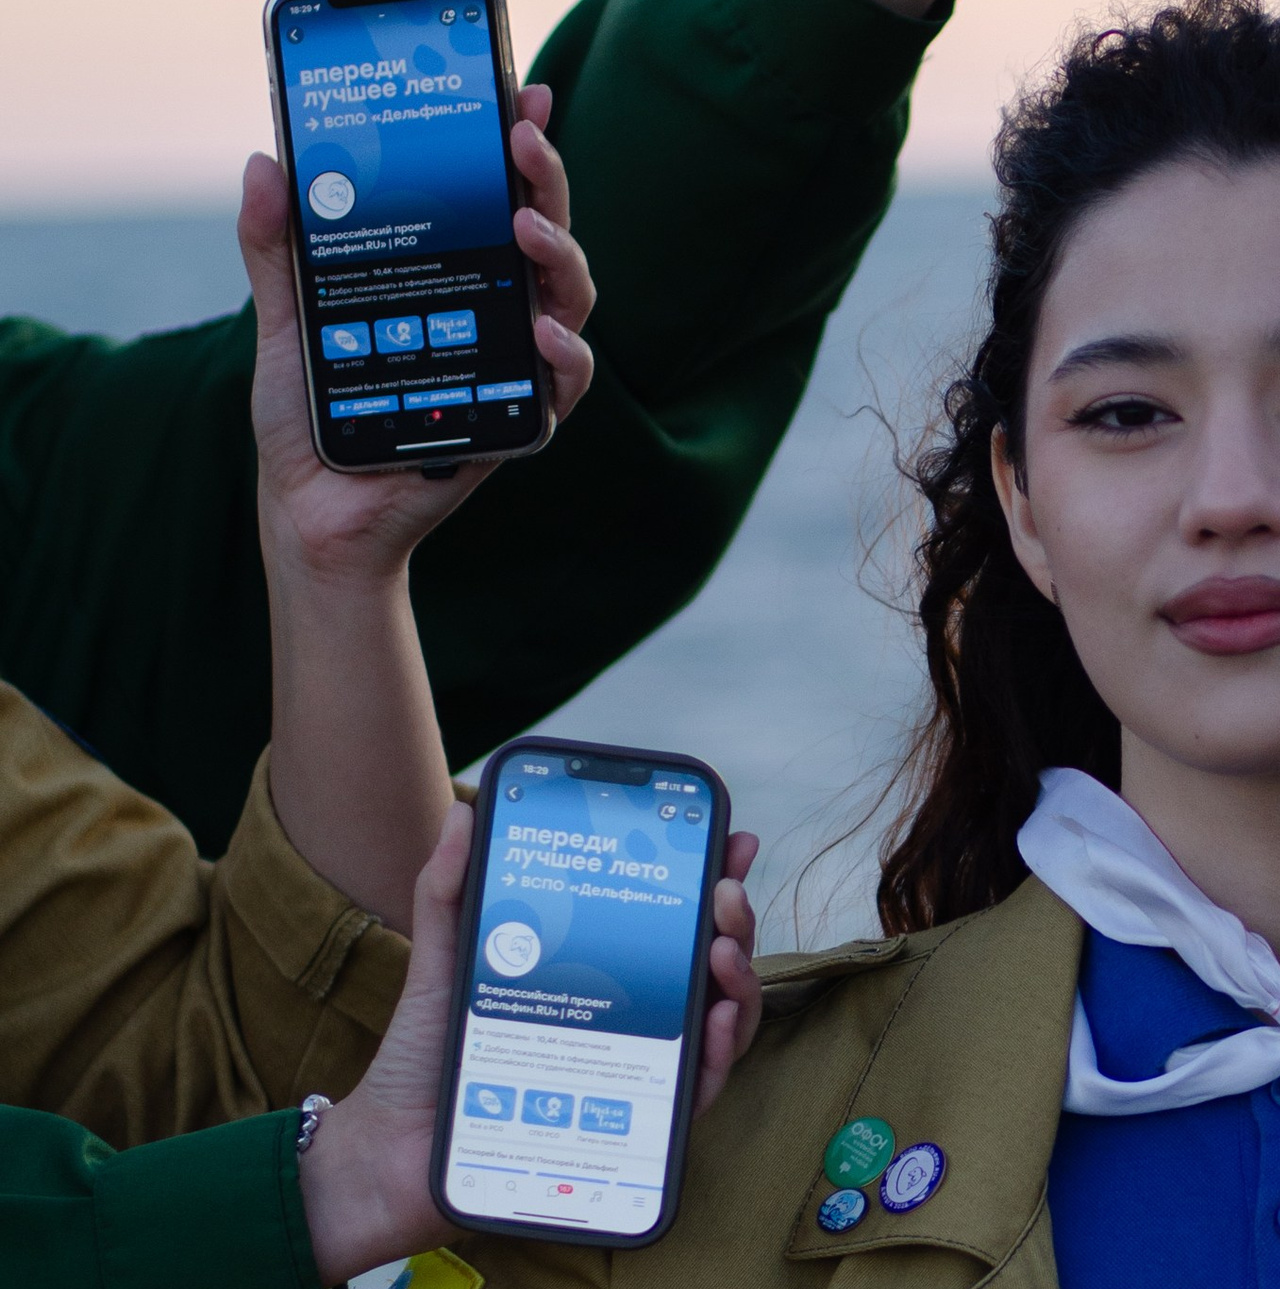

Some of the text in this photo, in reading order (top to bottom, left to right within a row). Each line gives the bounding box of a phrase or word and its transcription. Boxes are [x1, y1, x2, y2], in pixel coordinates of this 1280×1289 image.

[299, 58, 408, 90] впереди
[301, 73, 463, 113] лучшее лето
[323, 97, 482, 128] ВСПО «Дельфин.ru»
[309, 220, 432, 245] Всероссийский проект
[311, 235, 417, 258] «Дельфин.RU» РСО
[668, 782, 681, 792] LTE
[507, 823, 618, 858] впереди
[503, 845, 669, 882] лучшее лето
[521, 875, 683, 909] ВСПО «Дельфин.ru»
[475, 996, 592, 1021] «Дельфин.RU» РСО
[477, 982, 612, 1011] Всероссийский проект
